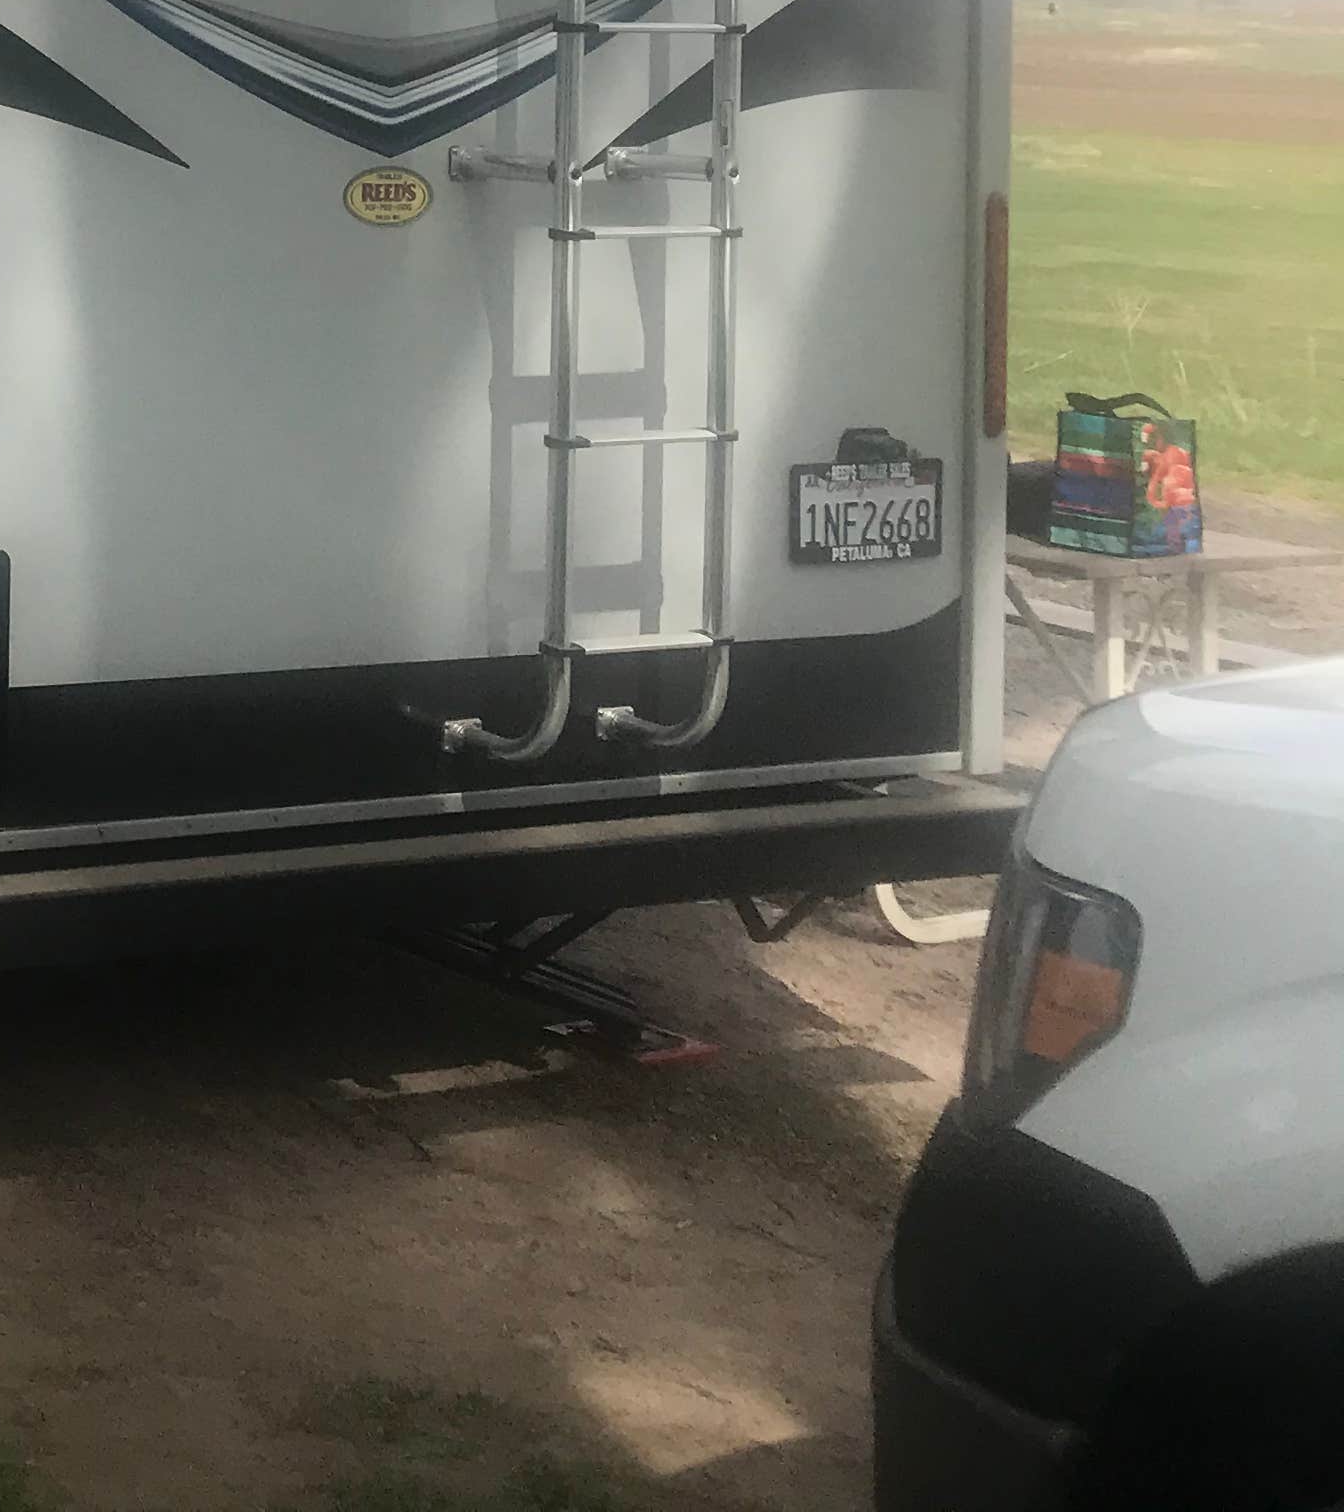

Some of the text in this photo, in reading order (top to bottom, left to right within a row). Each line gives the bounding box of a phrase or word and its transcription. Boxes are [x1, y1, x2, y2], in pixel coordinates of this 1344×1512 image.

[361, 182, 416, 202] REED'S
[806, 498, 930, 546] 1NF2668
[896, 542, 912, 558] CA
